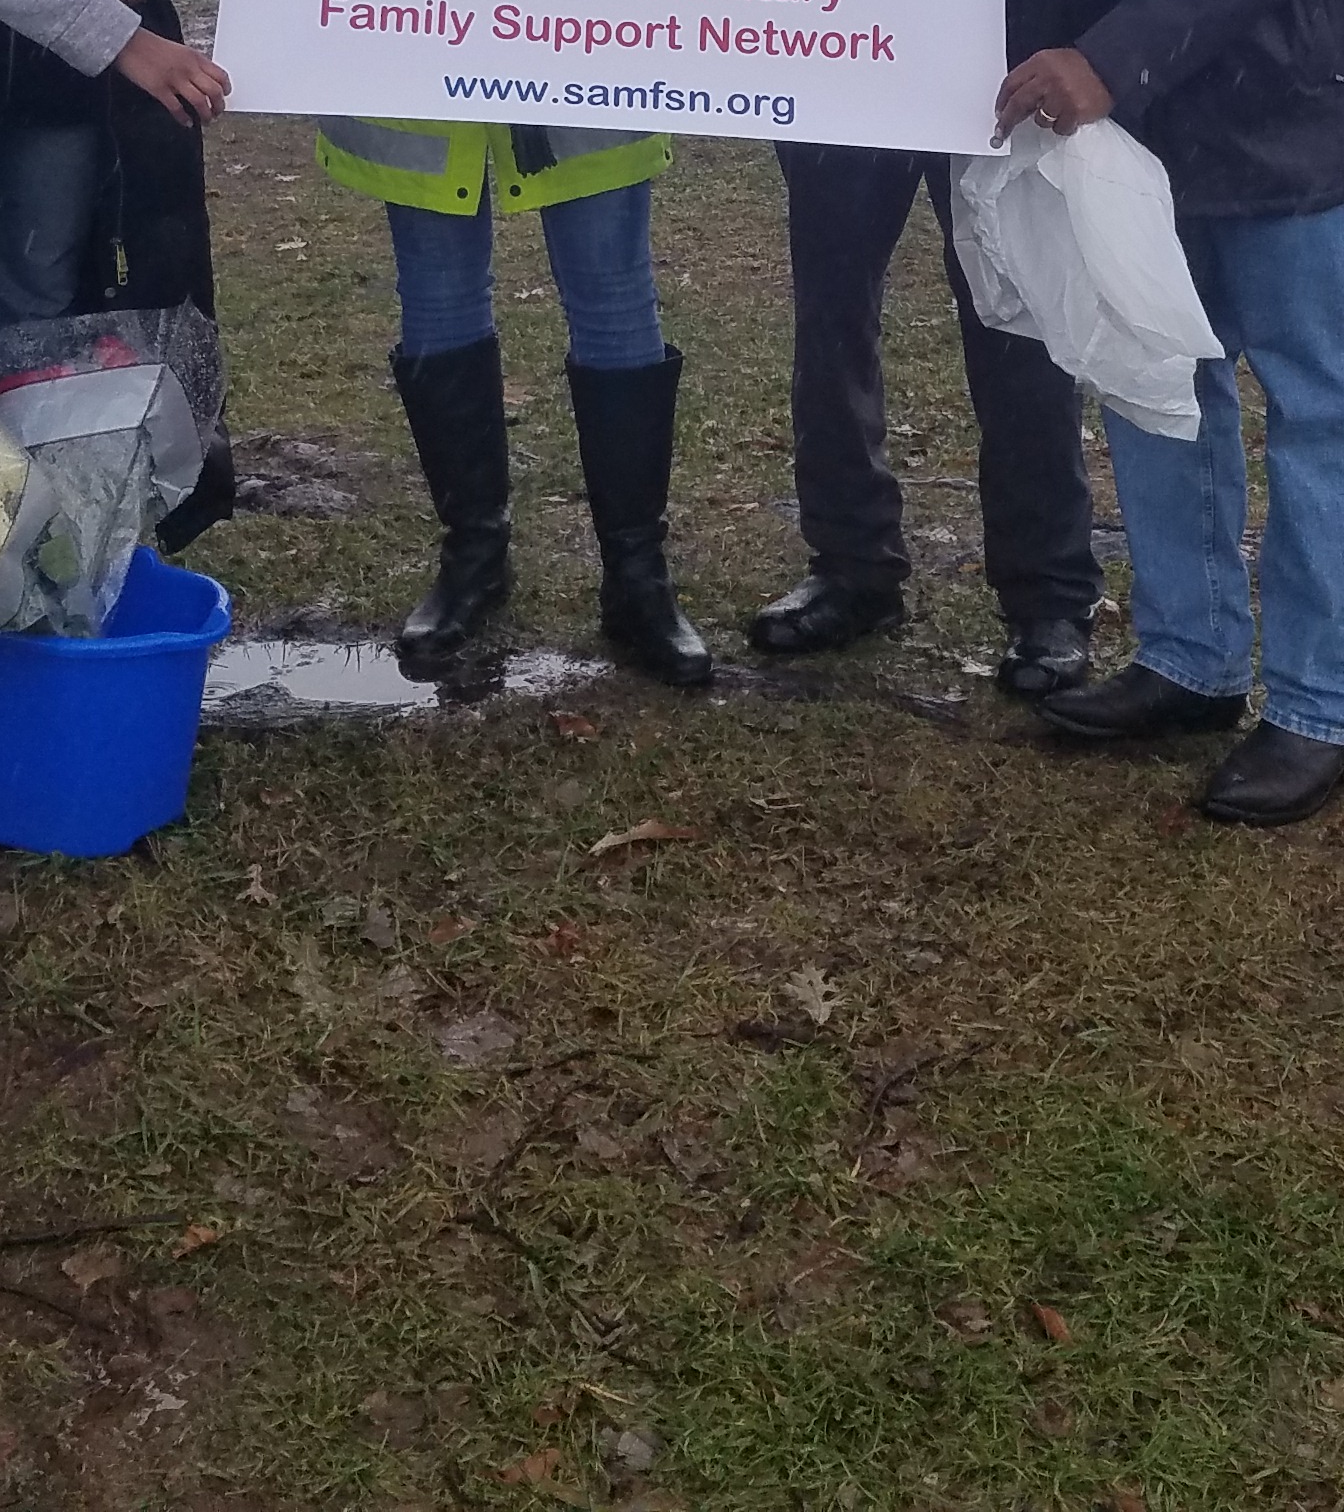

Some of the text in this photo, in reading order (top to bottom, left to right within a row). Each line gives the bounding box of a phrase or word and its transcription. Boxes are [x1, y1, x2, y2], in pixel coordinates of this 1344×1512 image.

[492, 4, 683, 55] Support
[699, 16, 895, 61] Network
[443, 75, 795, 126] www.samfsn.org
